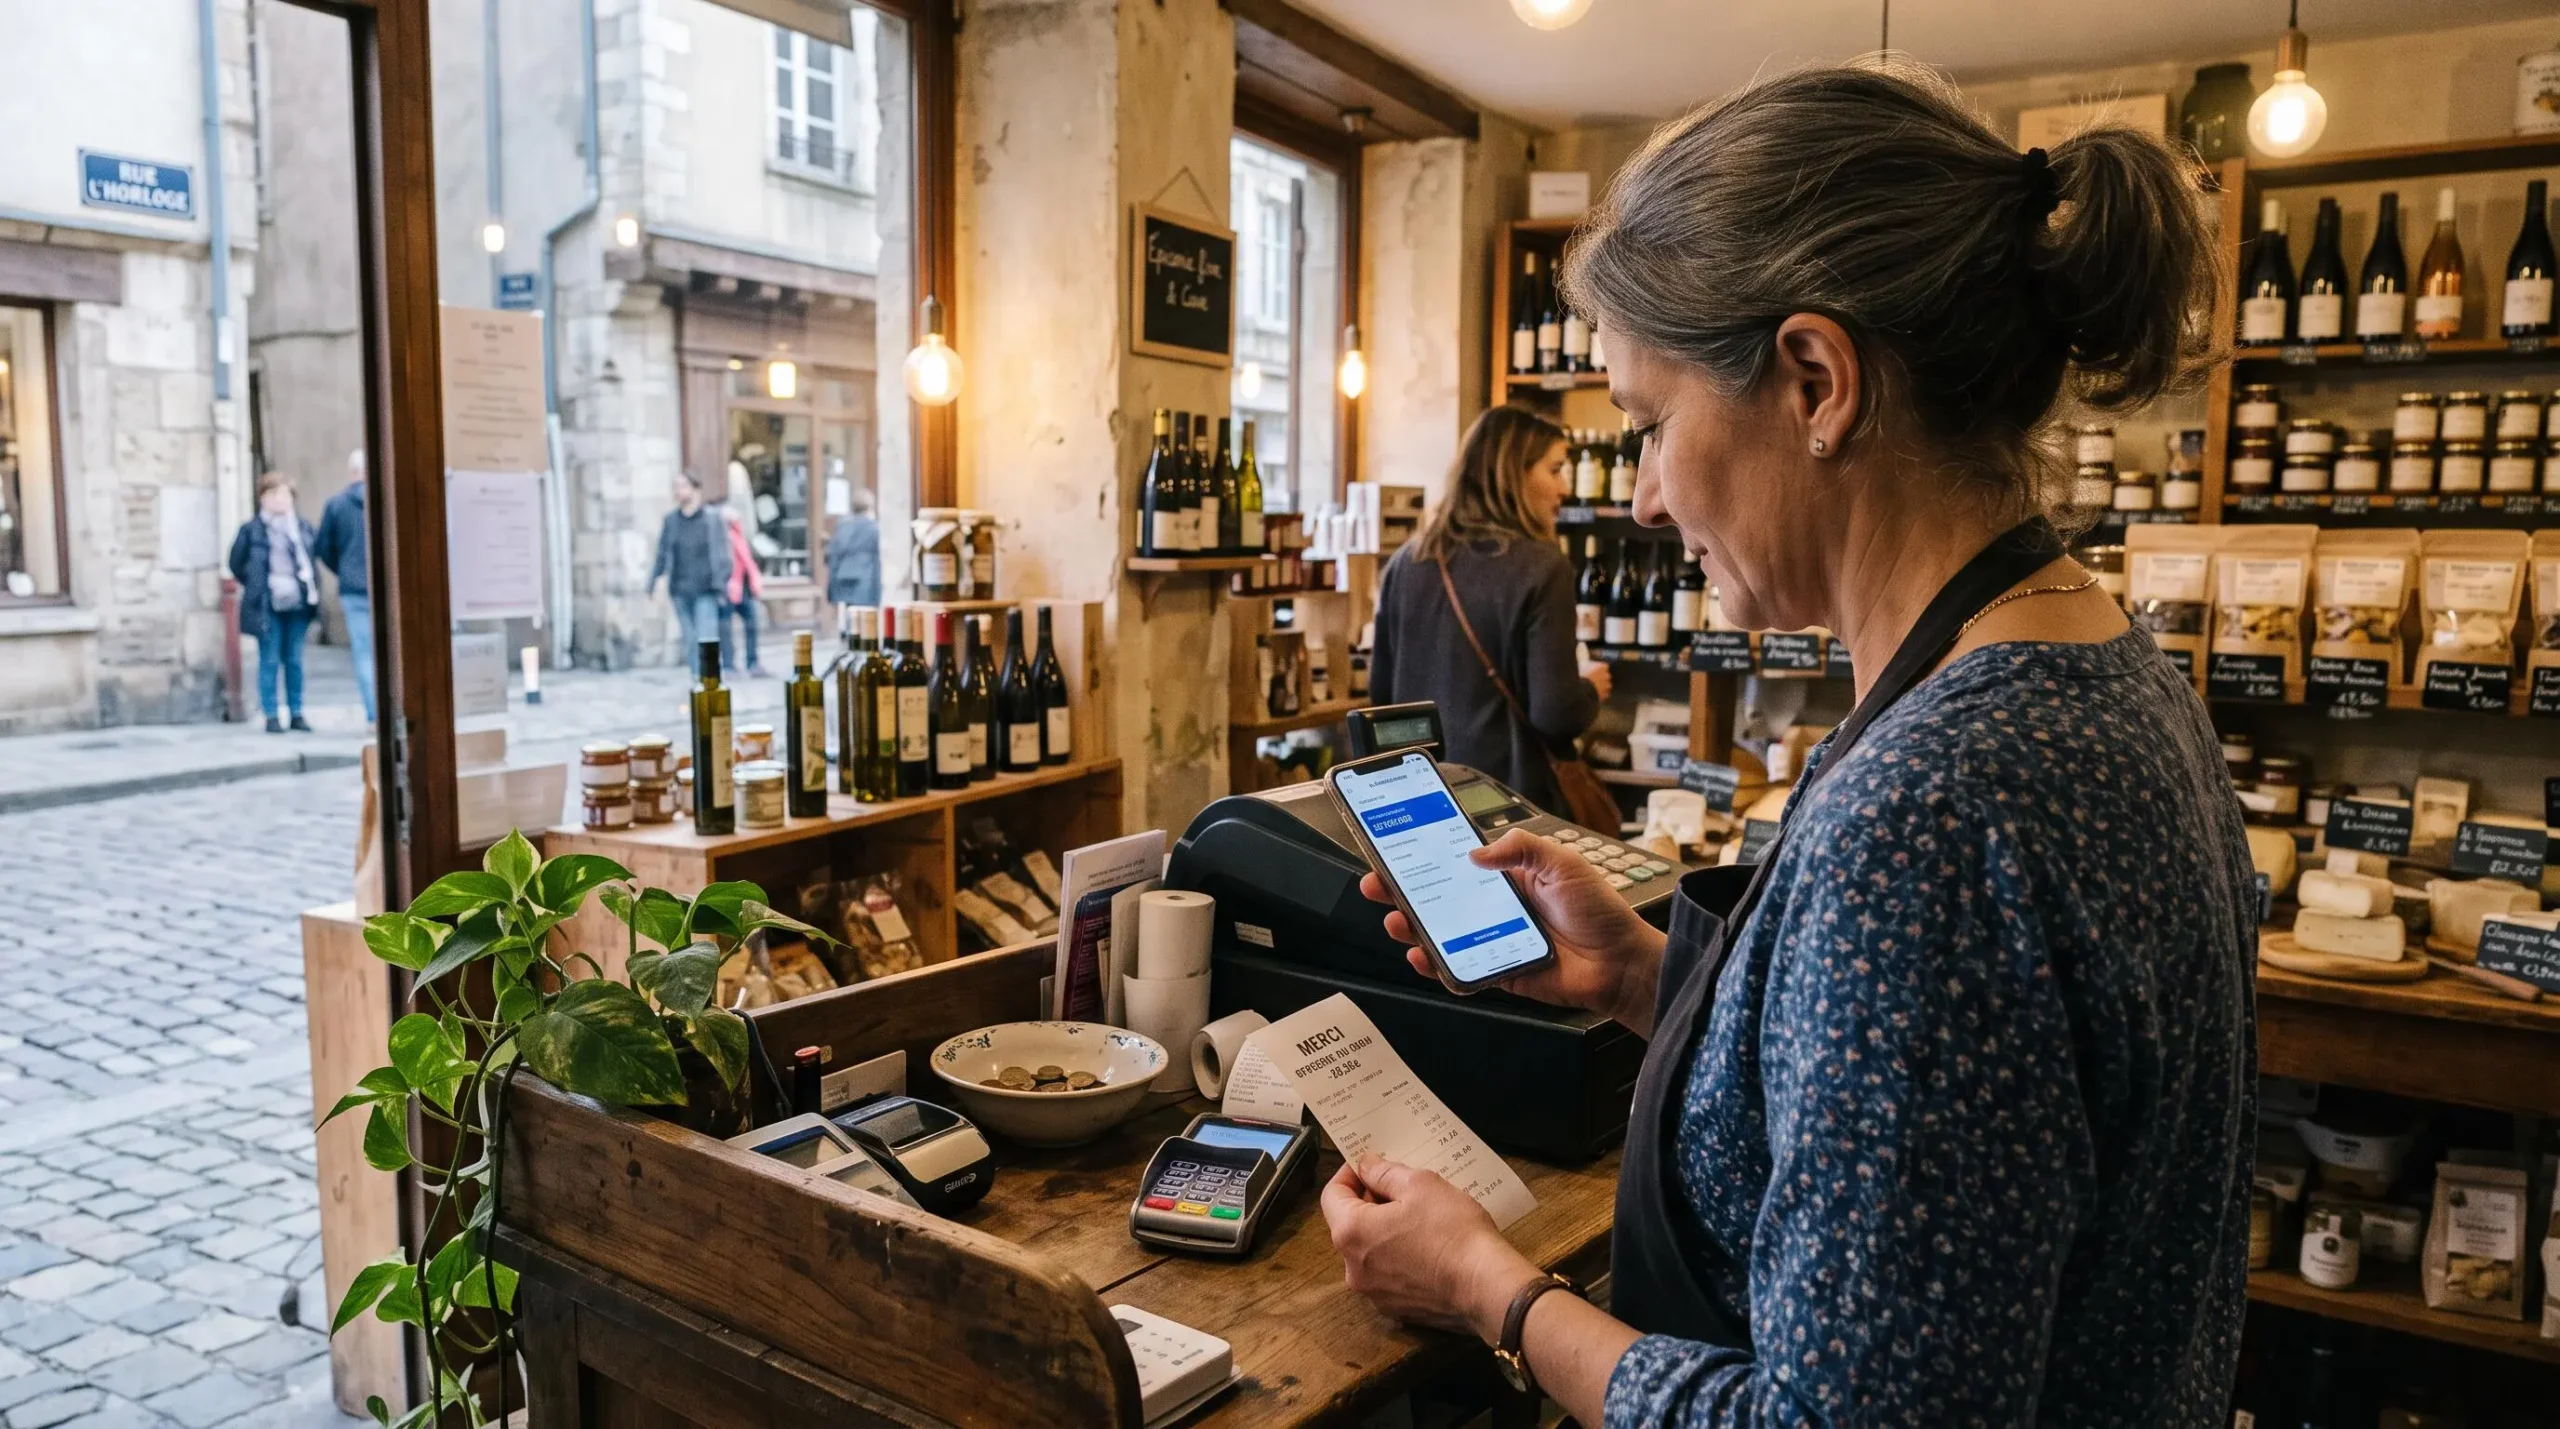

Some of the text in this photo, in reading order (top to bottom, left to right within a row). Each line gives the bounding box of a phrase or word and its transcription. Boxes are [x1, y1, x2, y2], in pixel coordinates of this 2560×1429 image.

[119, 161, 158, 187] RUE
[88, 178, 188, 211] L'HORLOGE
[1296, 1026, 1346, 1057] MERCI
